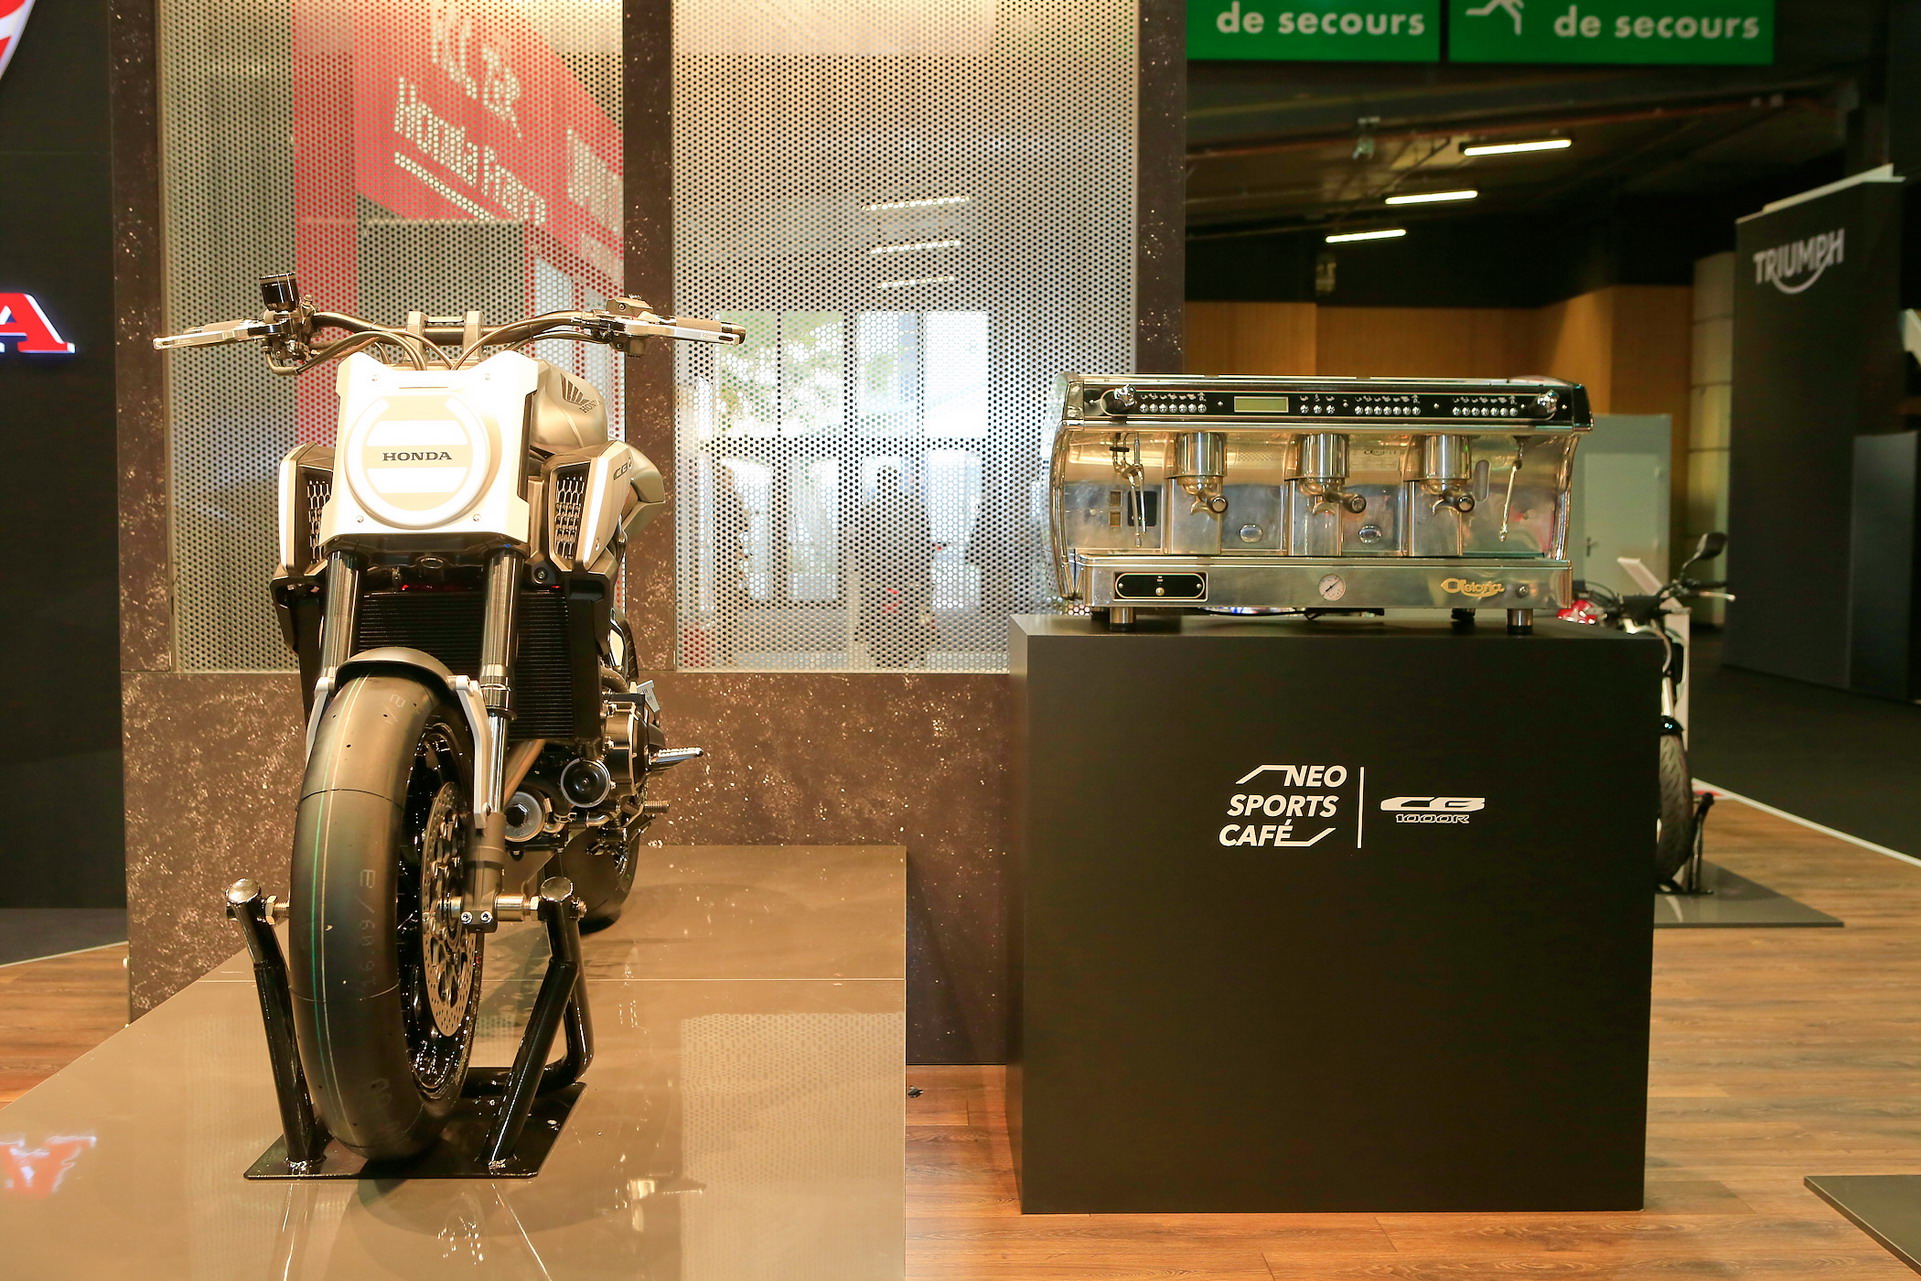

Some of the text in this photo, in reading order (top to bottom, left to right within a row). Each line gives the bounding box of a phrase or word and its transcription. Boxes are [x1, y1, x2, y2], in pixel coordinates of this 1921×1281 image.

[1216, 0, 1425, 35] de secours
[1554, 4, 1760, 39] de secours
[1753, 228, 1845, 294] TRIUMPH
[382, 452, 453, 462] HONDA
[1283, 765, 1348, 788] NEO
[1227, 794, 1339, 818] SPORTS
[1380, 796, 1486, 812] CB
[1395, 814, 1470, 824] 1000R
[1218, 819, 1295, 847] CAFÉ
